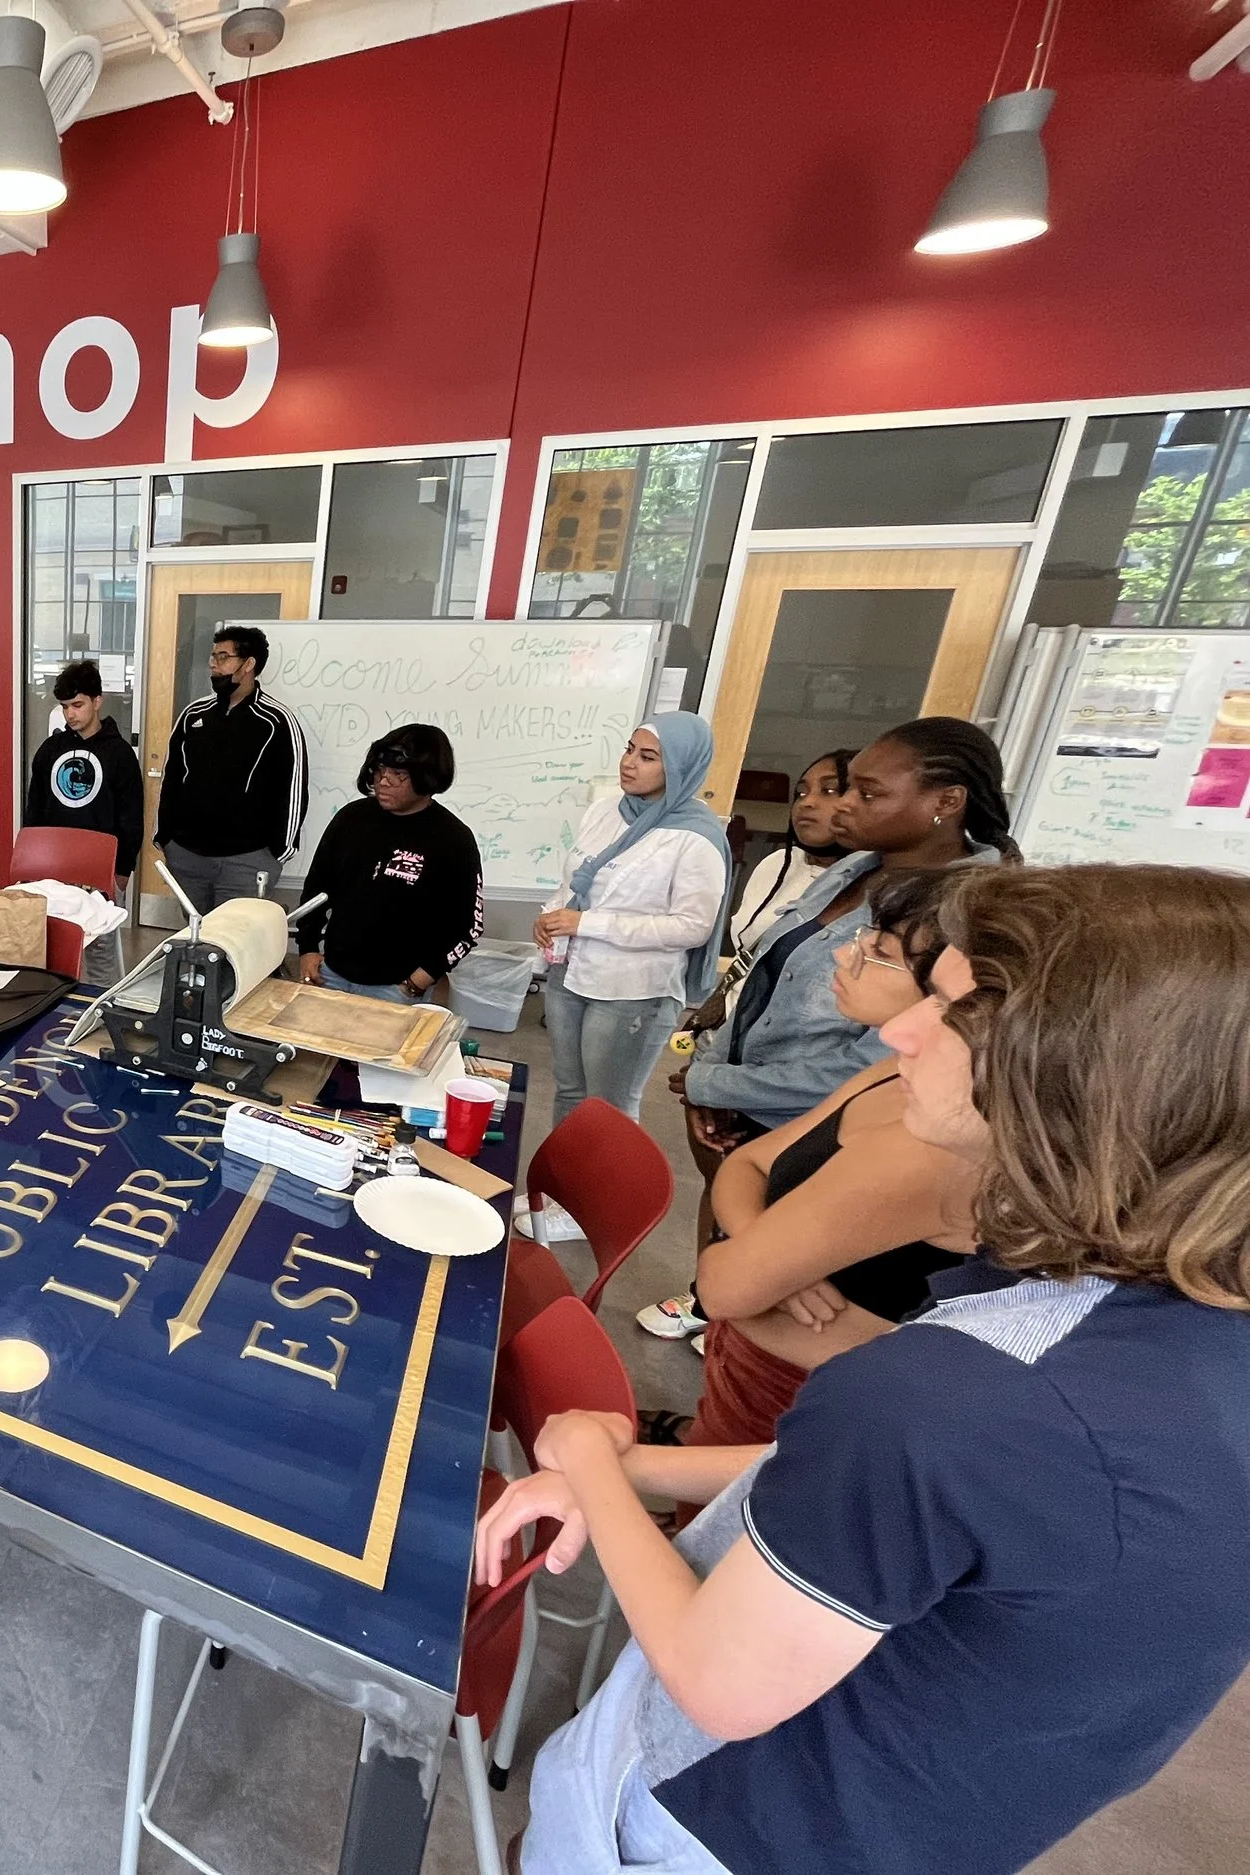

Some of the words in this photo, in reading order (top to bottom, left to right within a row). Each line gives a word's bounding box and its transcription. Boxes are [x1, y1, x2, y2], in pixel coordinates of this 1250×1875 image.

[202, 1025, 226, 1040] LADY
[40, 1099, 229, 1318] LIBRAR
[240, 1232, 382, 1391] EST.
